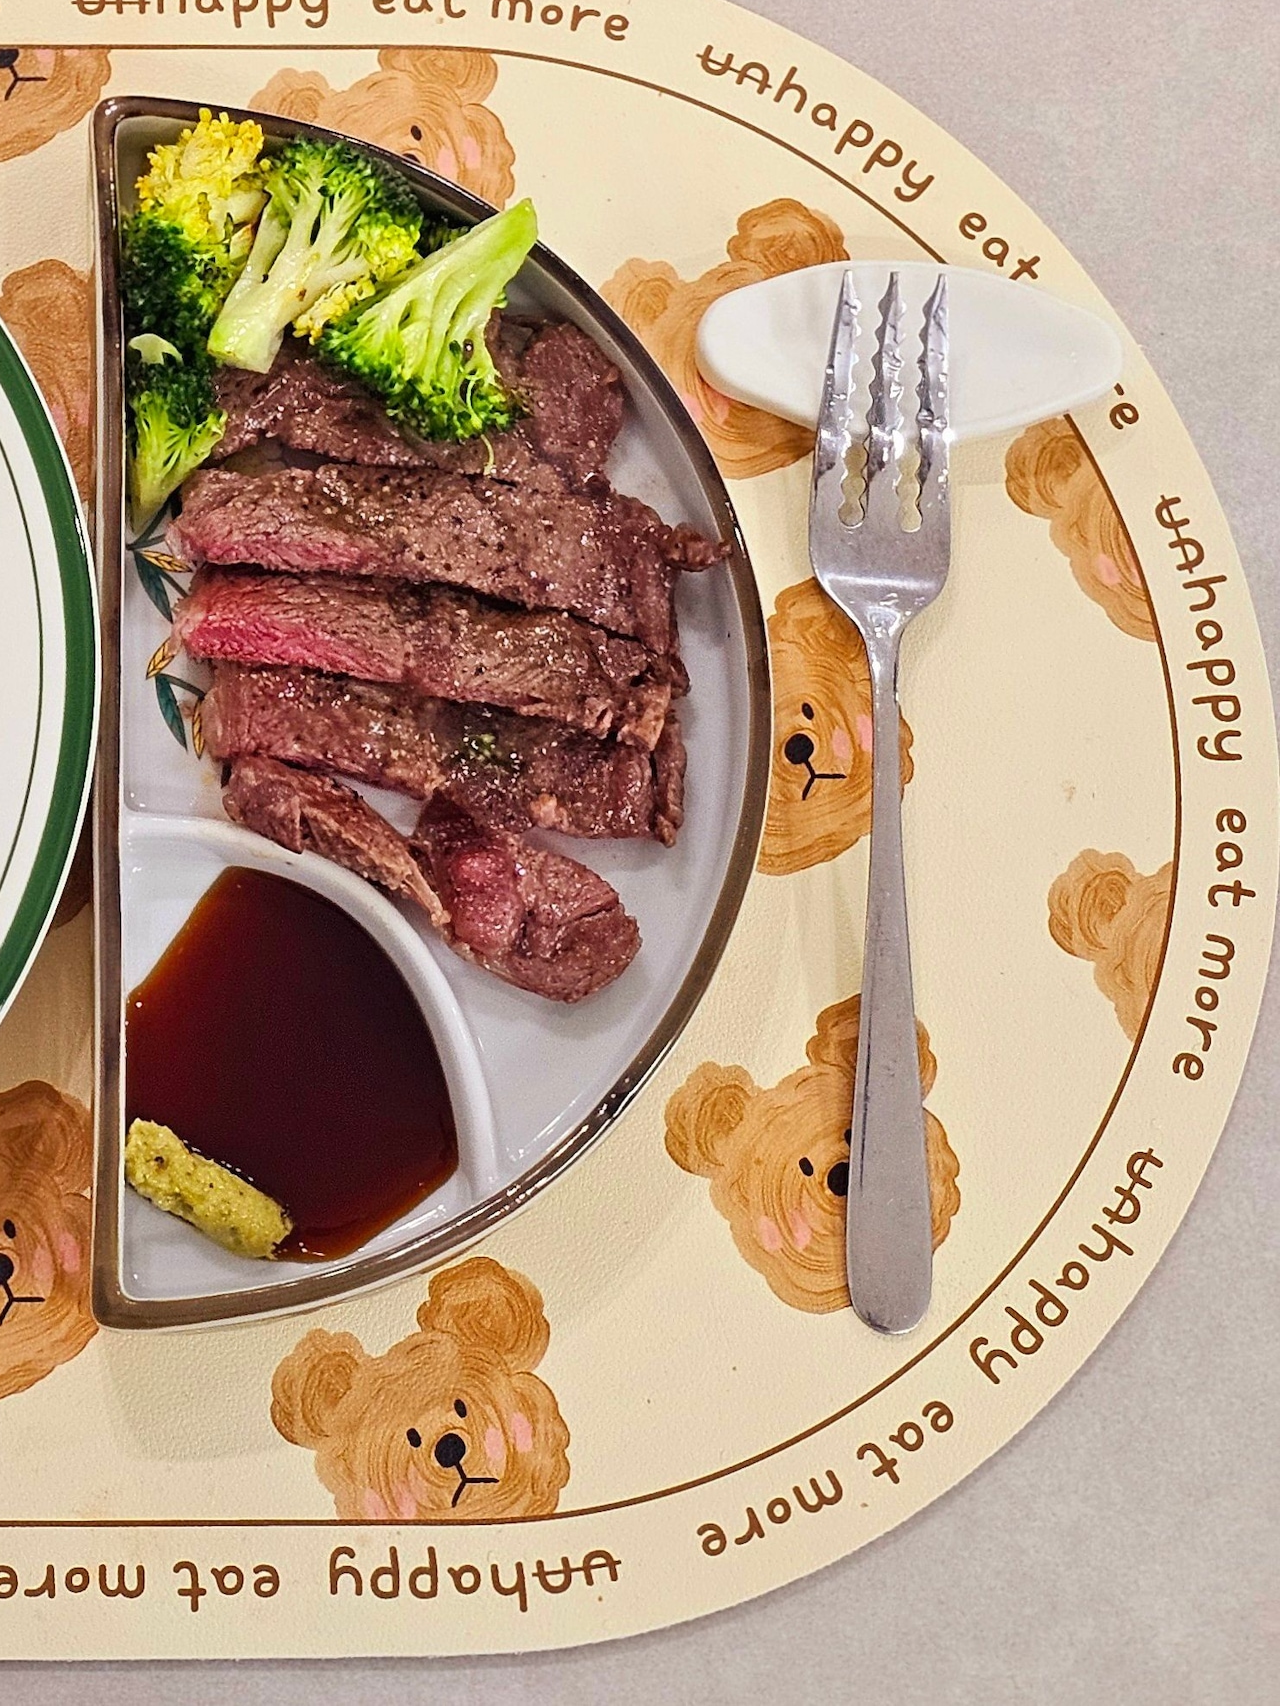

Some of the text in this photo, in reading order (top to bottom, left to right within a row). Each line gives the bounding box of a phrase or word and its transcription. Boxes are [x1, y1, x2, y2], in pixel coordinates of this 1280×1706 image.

[695, 44, 1041, 281] unhappy eat
[1154, 494, 1257, 1081] unhappy eat more
[696, 1147, 1164, 1557] unhappy eat more
[172, 1560, 280, 1613] eat
[329, 1545, 622, 1613] unhappy
